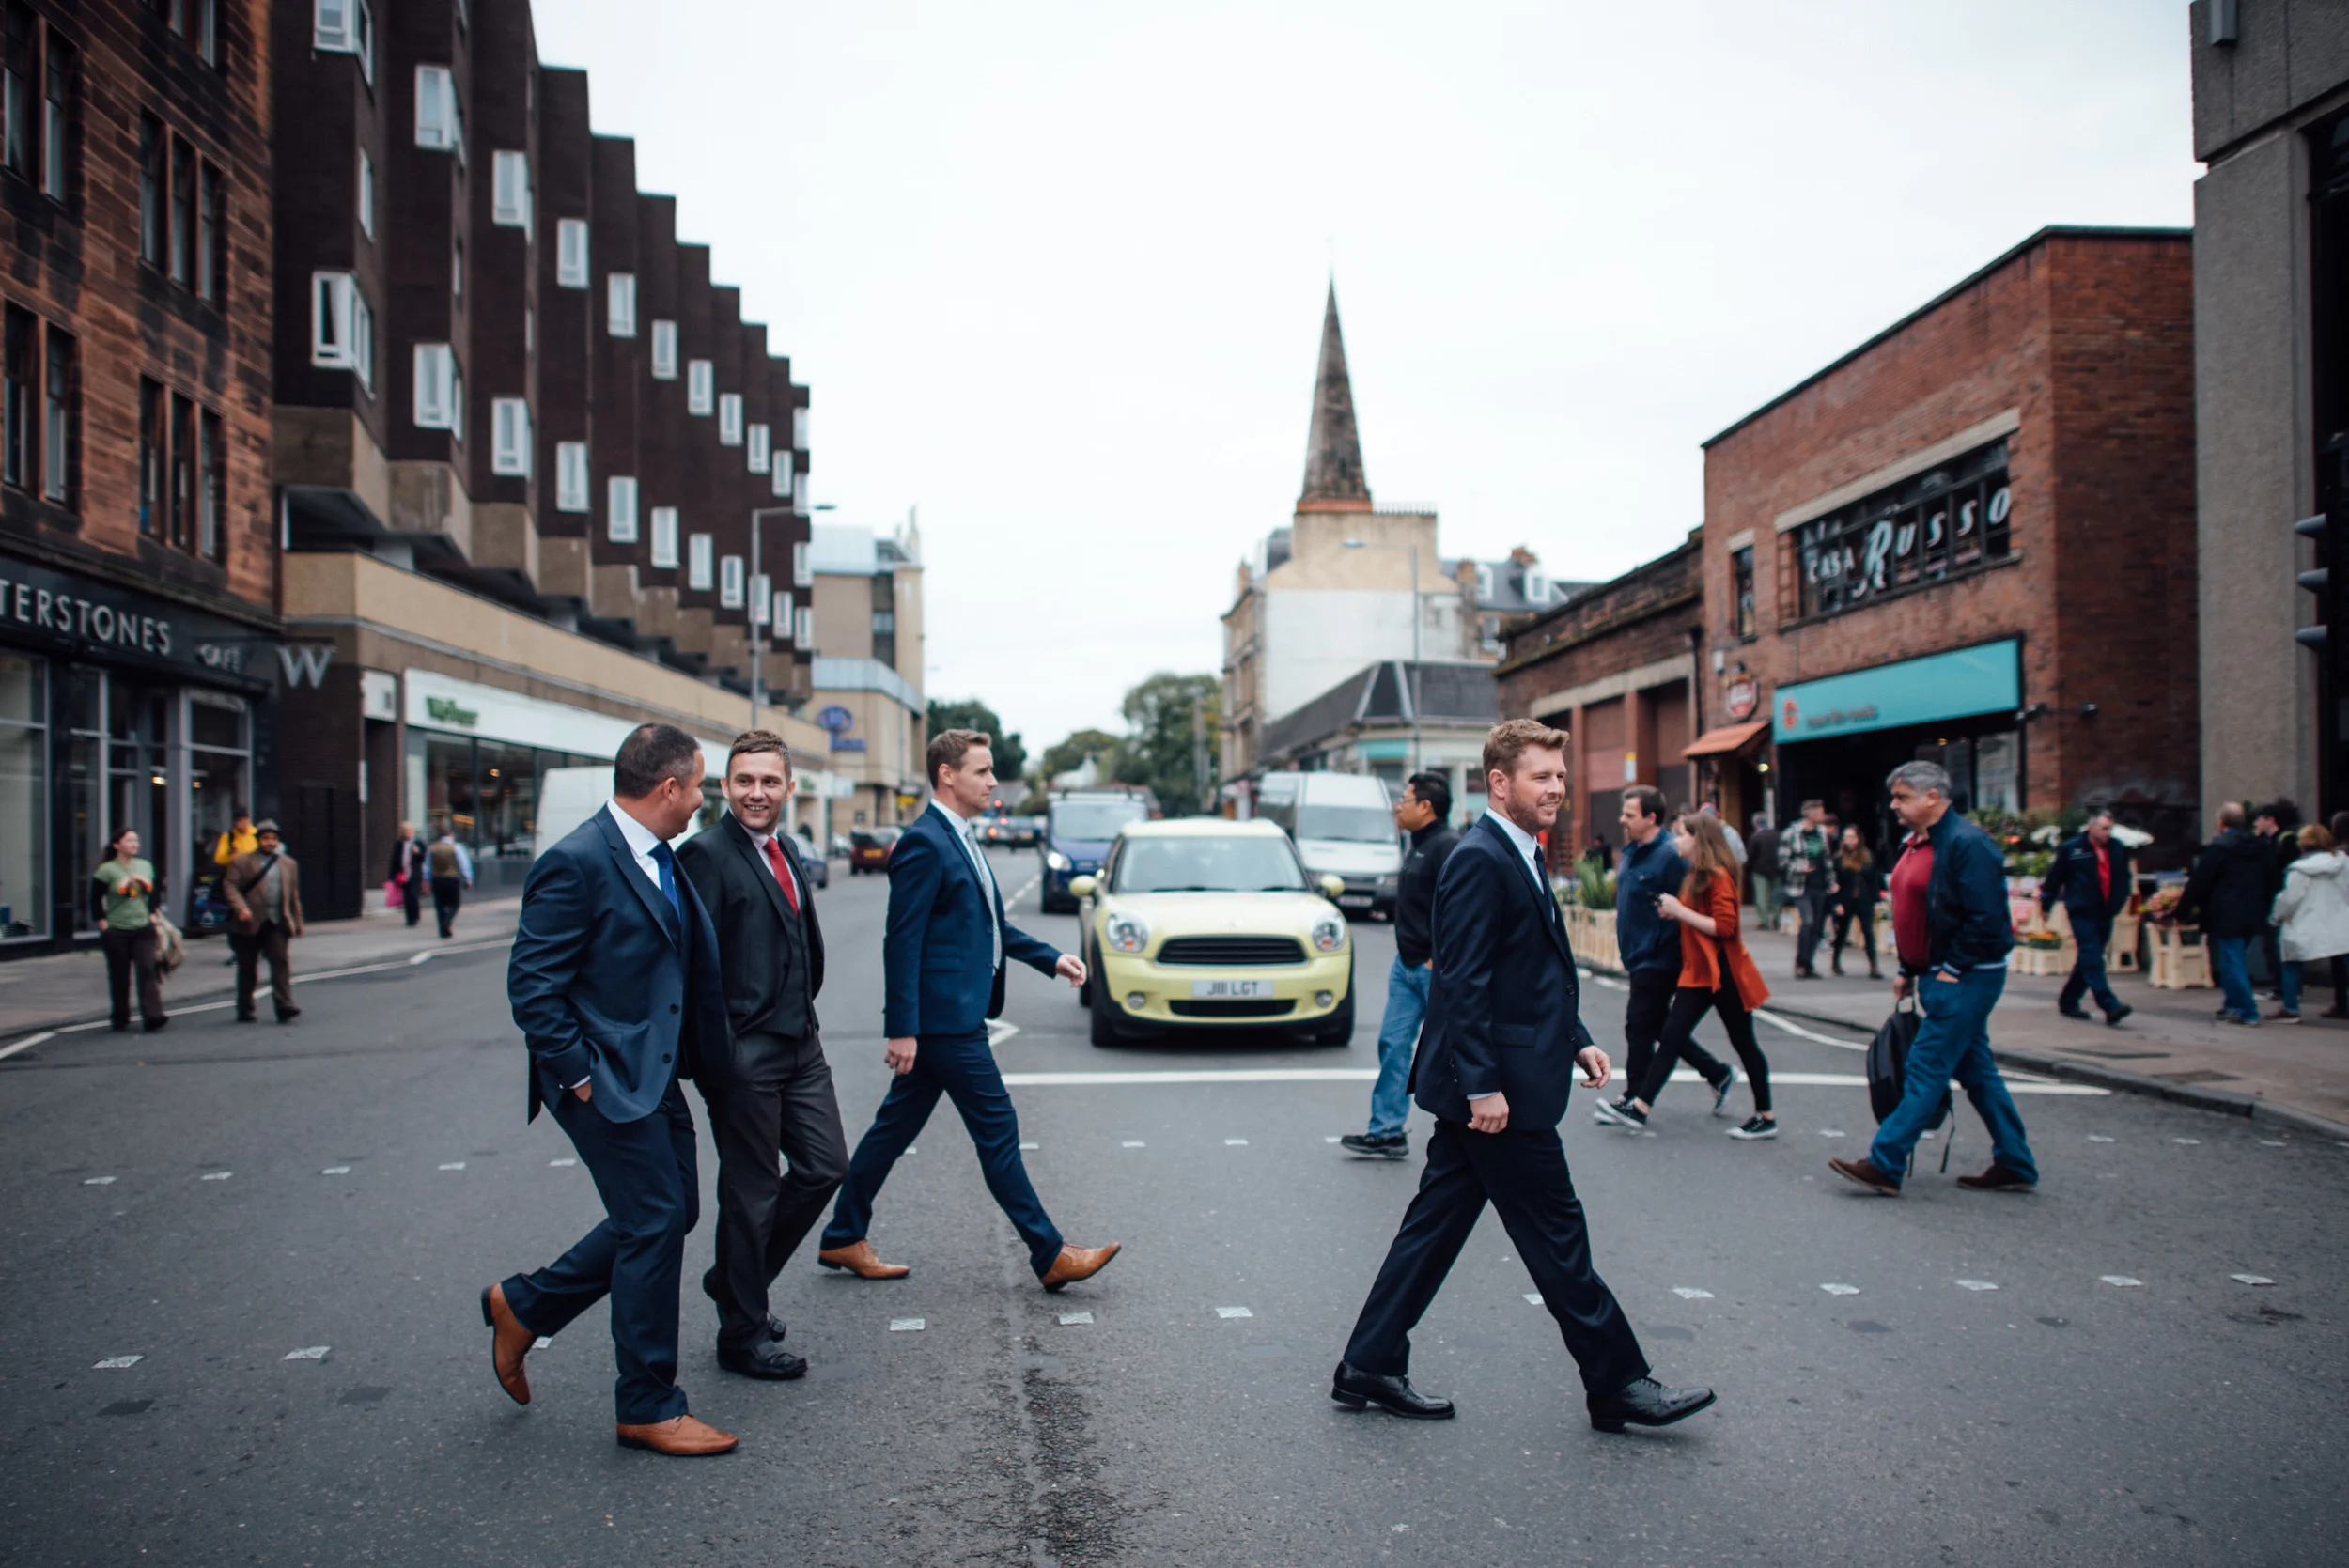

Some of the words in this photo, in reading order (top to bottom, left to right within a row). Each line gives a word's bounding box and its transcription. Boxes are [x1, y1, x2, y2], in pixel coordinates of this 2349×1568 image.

[1806, 545, 1856, 585] CASA
[1852, 486, 2012, 598] RUSSO
[0, 578, 172, 656] TERSTONES
[276, 644, 336, 688] W
